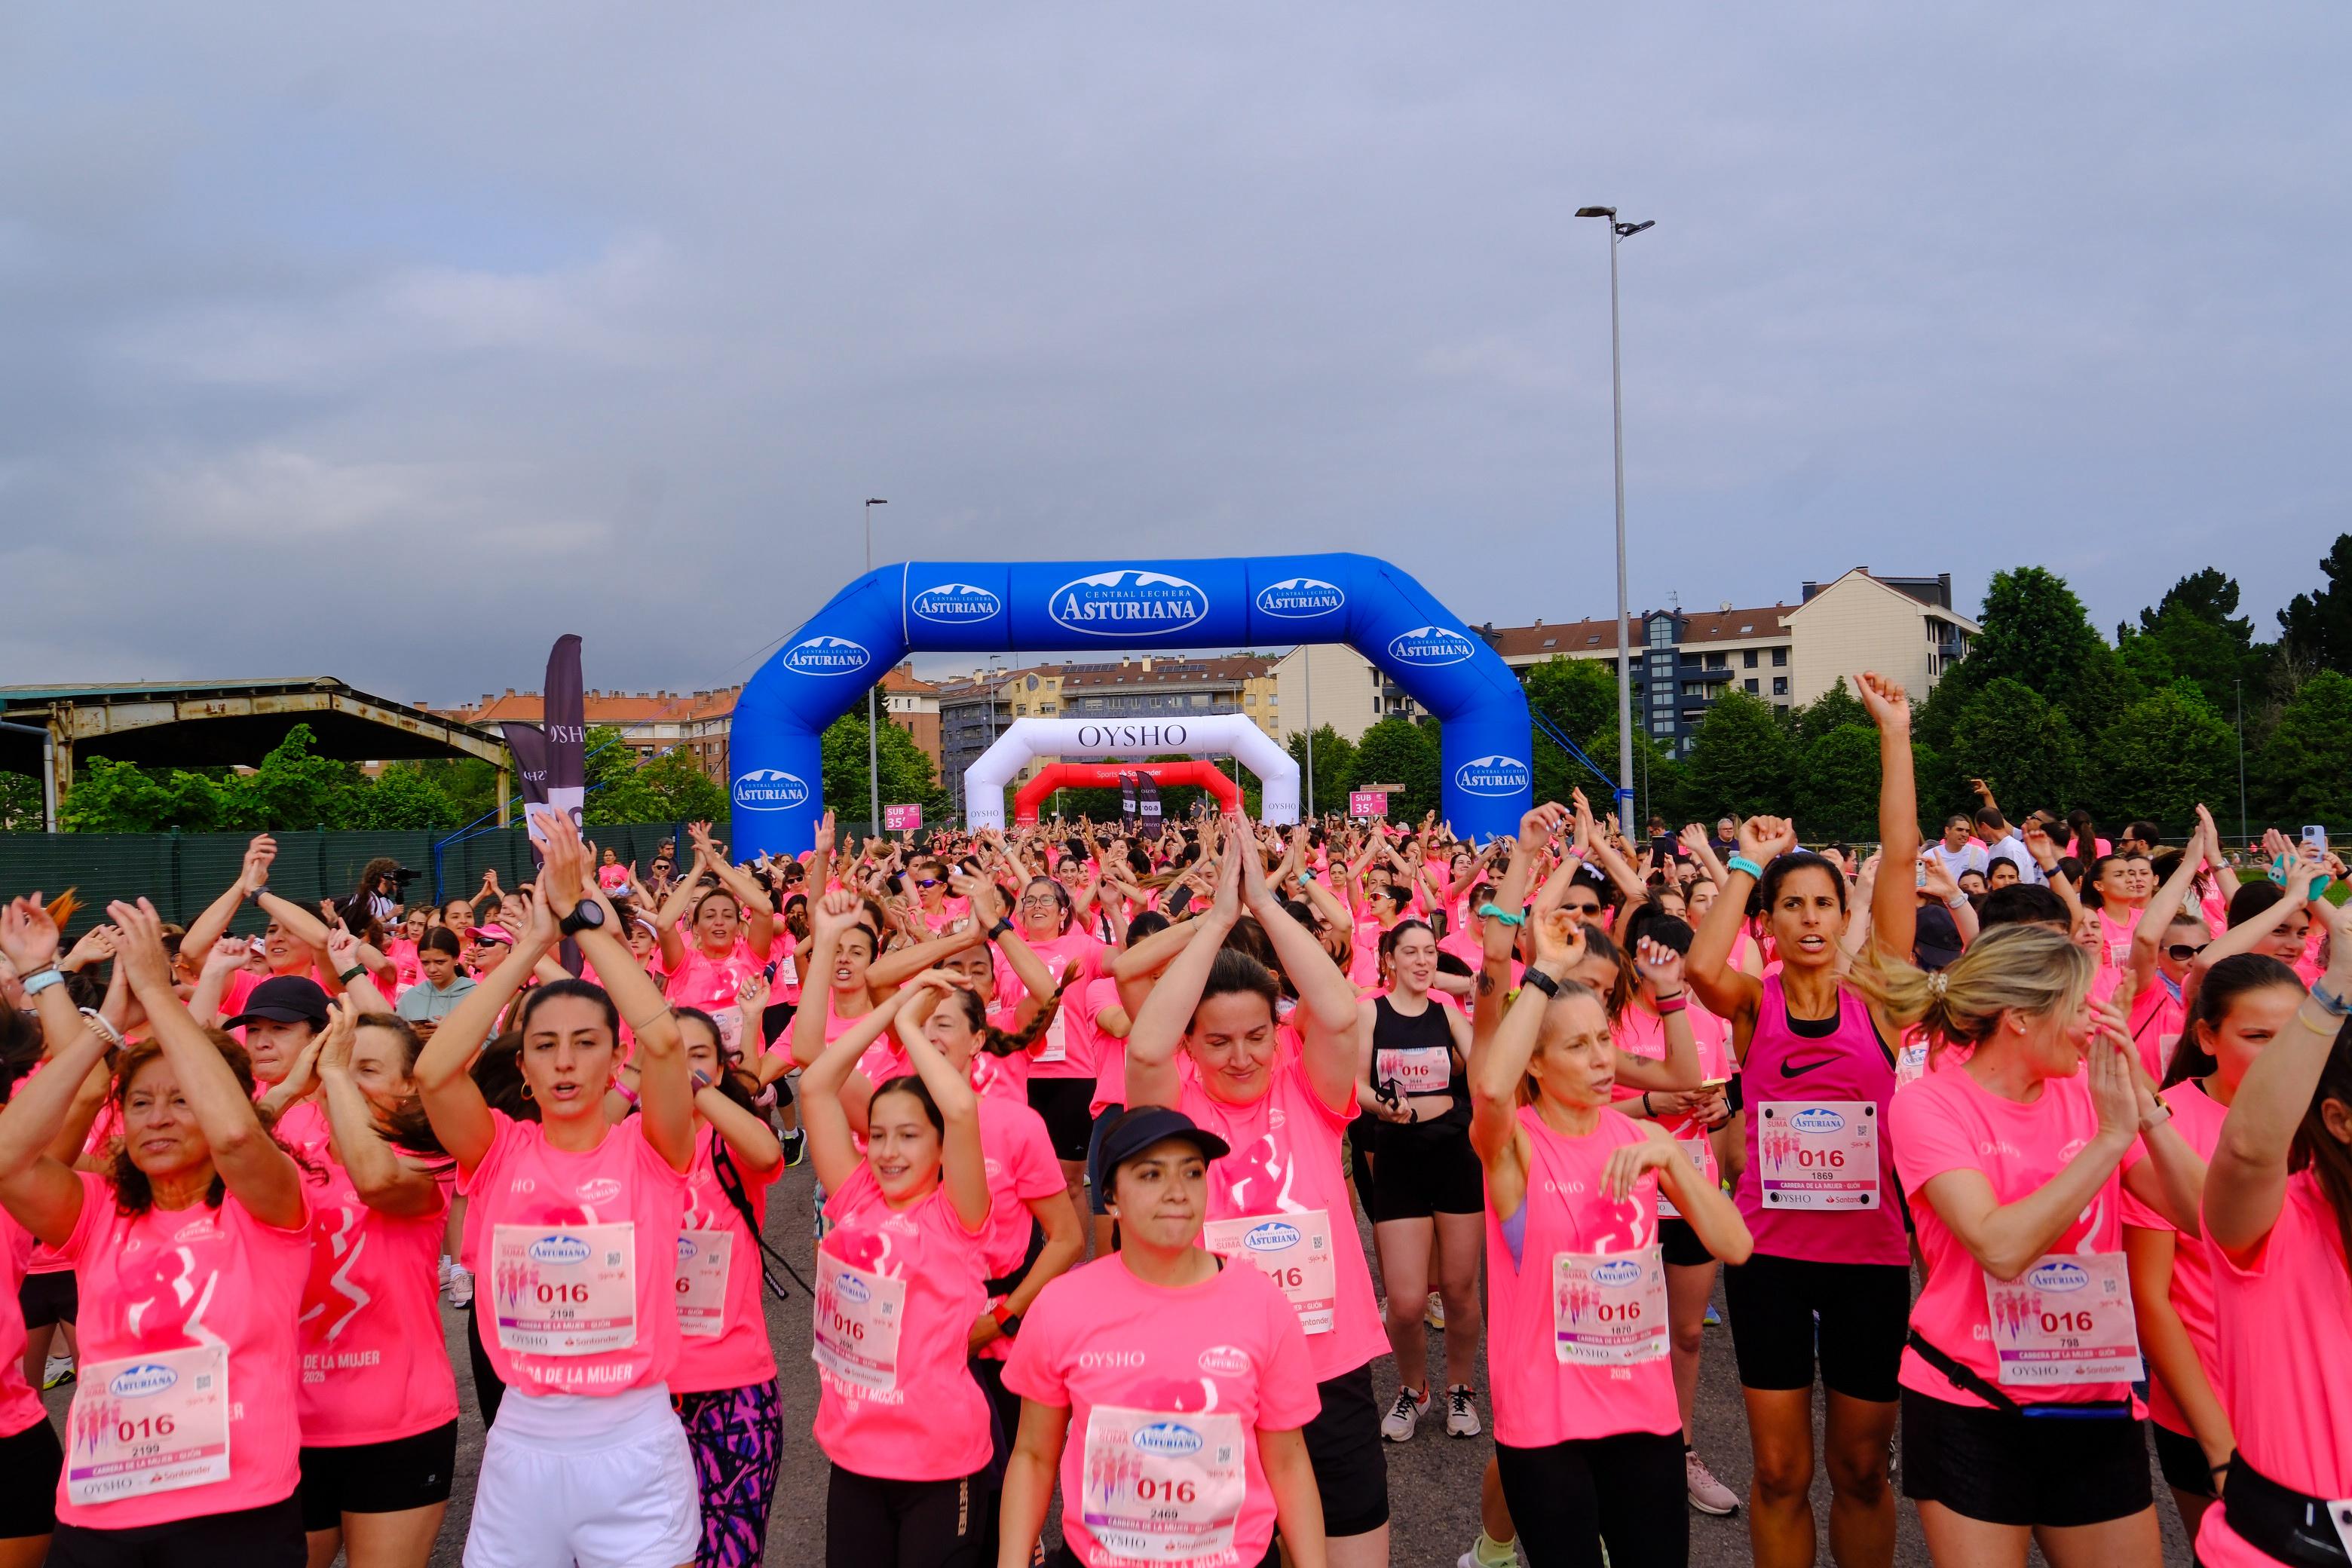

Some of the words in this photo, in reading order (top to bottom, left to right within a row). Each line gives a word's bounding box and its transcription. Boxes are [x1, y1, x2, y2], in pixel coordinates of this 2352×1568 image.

[919, 598, 994, 613] ASTURIANA
[1061, 593, 1197, 620] ASTURIANA
[1263, 593, 1338, 609] ASTURIANA
[1395, 643, 1469, 657] ASTURIANA
[789, 651, 863, 666] ASTURIANA
[1078, 724, 1187, 747] OYSHO
[1461, 771, 1526, 786] ASTURIANA
[737, 786, 804, 801] ASTURIANA
[971, 810, 999, 818] OYSHO
[1402, 1065, 1429, 1076] 016
[1795, 1118, 1841, 1128] ASTURIANA
[1799, 1150, 1845, 1168] 016
[1811, 1172, 1833, 1181] 1869
[1545, 1181, 1584, 1193] OSHO
[1216, 1241, 1242, 1250] SUMA
[1249, 1234, 1297, 1246] ASTURIANA
[534, 1246, 586, 1257] ASTURIANA
[1265, 1267, 1303, 1288] 16
[1594, 1269, 1638, 1281] ASTURIANA
[2035, 1270, 2085, 1285] ASTURIANA
[537, 1283, 589, 1303] 016
[550, 1309, 574, 1319] 2198
[1598, 1302, 1640, 1321] 016
[834, 1313, 864, 1340] 016
[1612, 1326, 1631, 1334] 1870
[2041, 1312, 2093, 1333] 016
[576, 1336, 618, 1346] Santander
[2060, 1339, 2080, 1348] 798
[304, 1354, 318, 1370] DE
[320, 1353, 335, 1369] LA
[338, 1350, 380, 1367] MUJER
[1080, 1350, 1145, 1369] OYSHO
[303, 1370, 326, 1383] 2025
[545, 1367, 563, 1384] DE
[567, 1366, 583, 1384] LA
[587, 1364, 632, 1384] MUJER
[1611, 1368, 1631, 1380] 2025
[2012, 1366, 2058, 1376] OYSHO
[2086, 1364, 2125, 1374] Santander
[115, 1377, 173, 1393] ASTURIANA
[118, 1414, 176, 1442] 016
[1137, 1432, 1197, 1448] ASTURIANA
[133, 1444, 160, 1457] 2199
[164, 1465, 211, 1479] Santander
[84, 1478, 132, 1496] OYSHO
[1137, 1477, 1196, 1504] 016
[1098, 1533, 1146, 1550] OYSHO
[1193, 1546, 1240, 1568] MUJER
